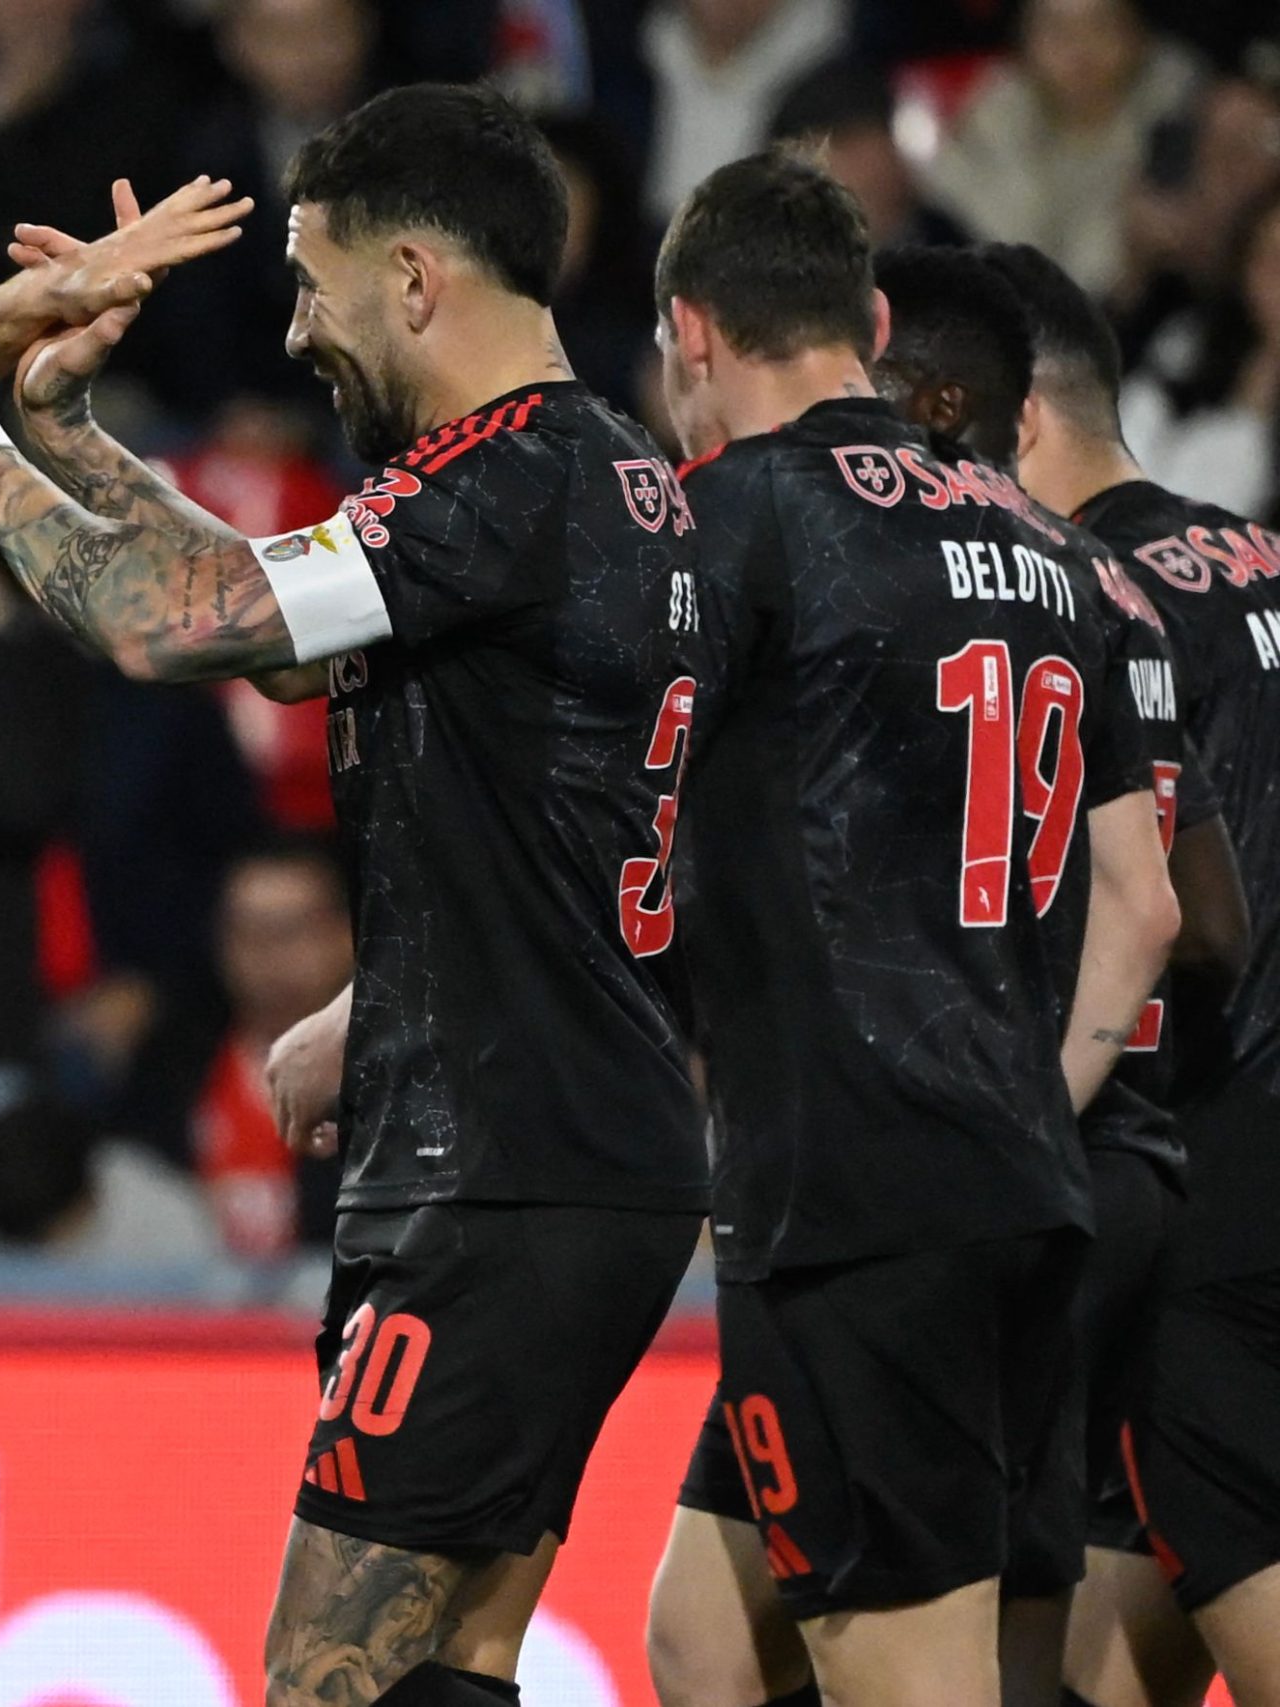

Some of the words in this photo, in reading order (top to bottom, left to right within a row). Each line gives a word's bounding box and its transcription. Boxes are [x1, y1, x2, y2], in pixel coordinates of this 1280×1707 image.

[940, 539, 1076, 622] BELOTTI
[936, 639, 1085, 928] 19
[320, 1302, 432, 1437] 30
[723, 1393, 798, 1520] 19
